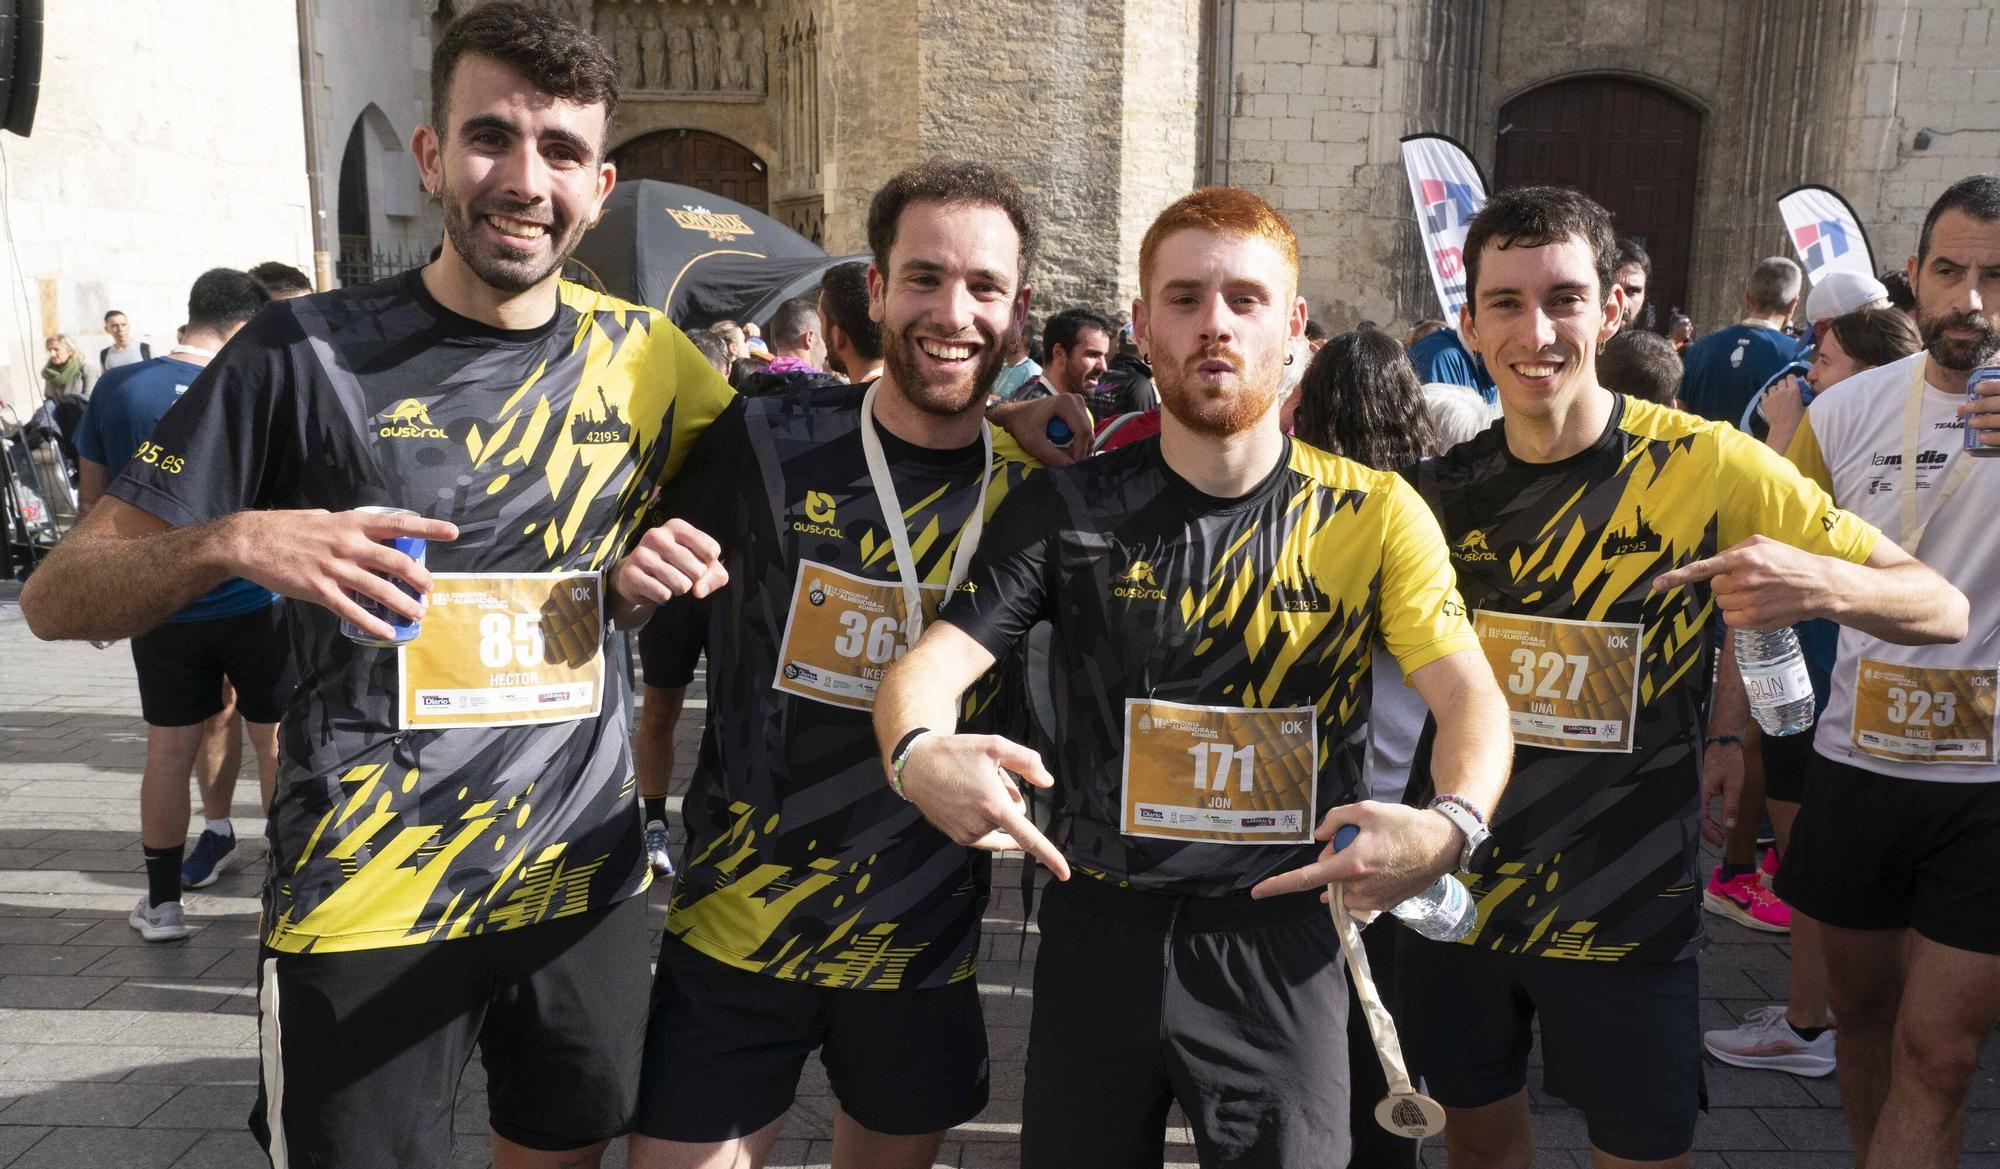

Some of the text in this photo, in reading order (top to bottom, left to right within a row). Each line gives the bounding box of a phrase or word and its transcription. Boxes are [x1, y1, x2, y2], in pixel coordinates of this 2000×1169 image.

[380, 426, 449, 439] austral
[586, 431, 620, 443] 42195
[1871, 450, 1948, 466] lamdia
[793, 521, 845, 539] austral
[571, 587, 591, 602] 10K
[1114, 587, 1167, 600] austral
[839, 595, 877, 608] ALMENDRA
[1284, 600, 1319, 611] 42195
[479, 612, 545, 669] 85
[1607, 635, 1629, 649] 10K
[490, 672, 539, 687] HECTOR
[1508, 648, 1590, 701] 327
[1971, 676, 1990, 687] 10K
[1531, 702, 1557, 715] UNAI
[1887, 687, 1957, 727] 323
[1172, 725, 1210, 734] ALMENDRA
[1280, 720, 1303, 735] 10K
[1904, 728, 1932, 739] MIKEL
[1187, 742, 1255, 792] 171
[1208, 796, 1232, 809] JON
